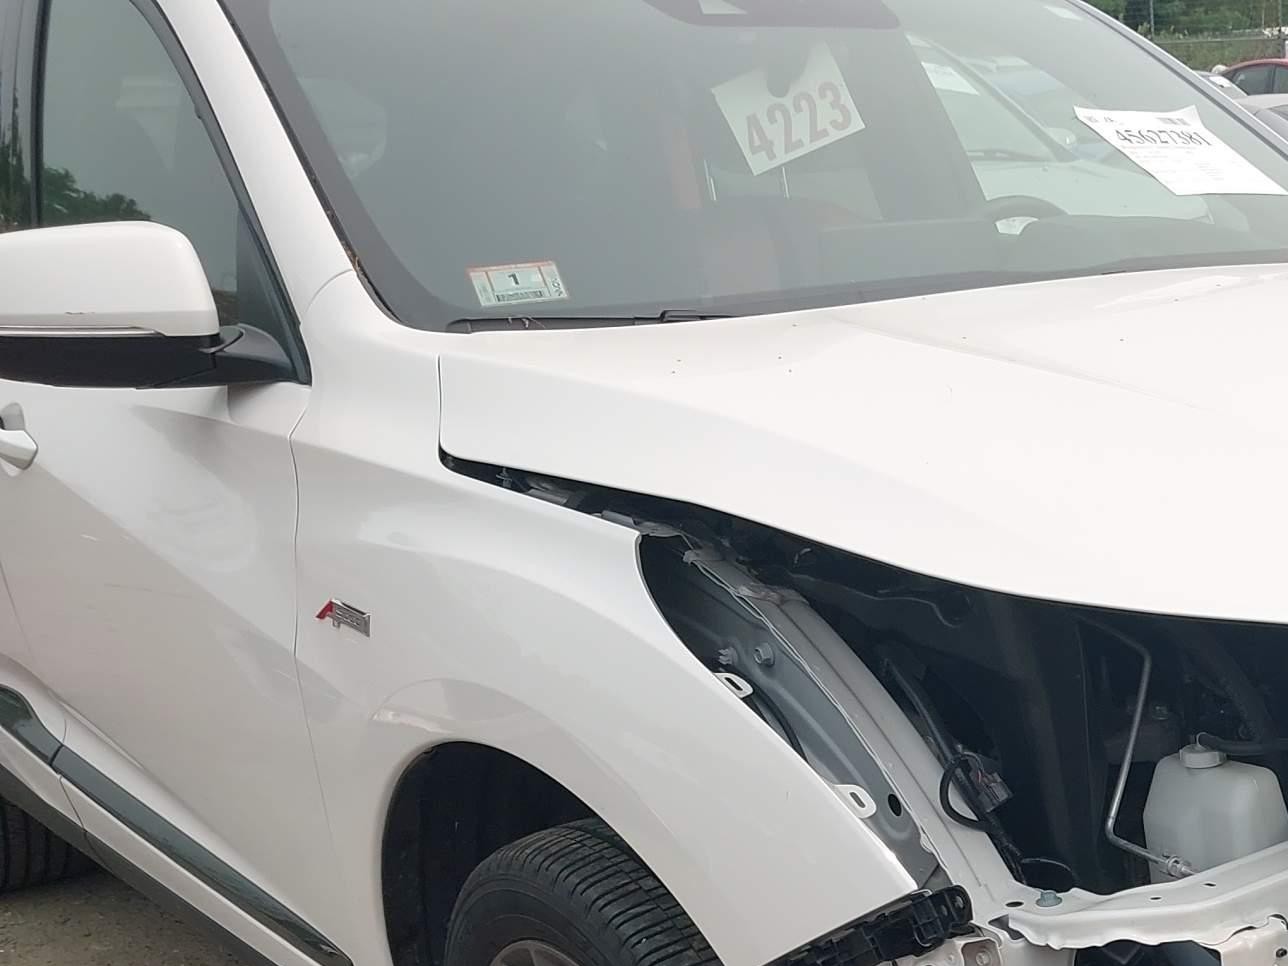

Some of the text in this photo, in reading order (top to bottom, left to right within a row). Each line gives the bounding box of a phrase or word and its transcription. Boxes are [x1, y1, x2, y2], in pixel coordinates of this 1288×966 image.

[746, 81, 852, 161] 4223
[1114, 129, 1213, 146] 45627381
[508, 273, 520, 286] 1
